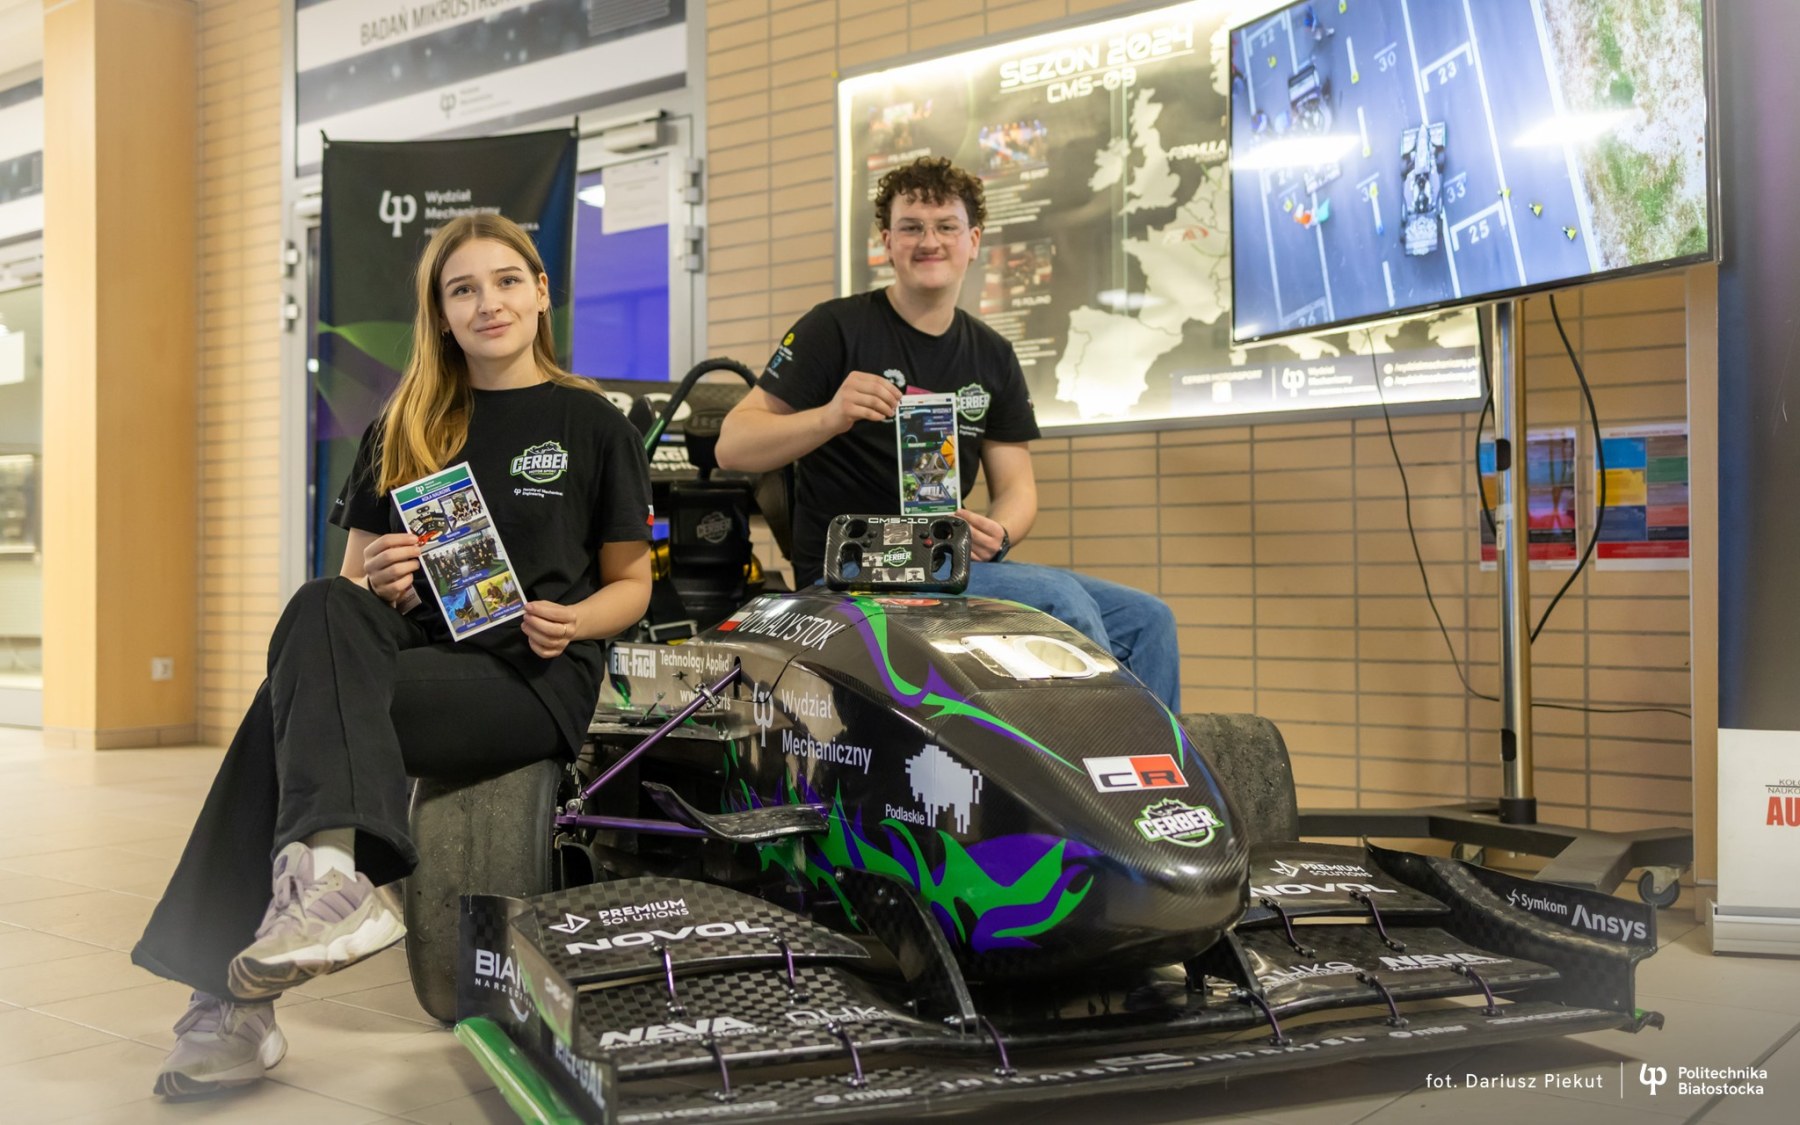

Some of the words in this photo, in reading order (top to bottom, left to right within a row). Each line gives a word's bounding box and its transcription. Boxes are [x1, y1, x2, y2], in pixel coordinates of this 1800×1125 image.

[1259, 28, 1275, 48] 22
[1000, 45, 1099, 89] SEZON
[1106, 22, 1194, 66] 2024
[1378, 52, 1397, 72] 30
[1438, 61, 1457, 85] 23
[1046, 67, 1137, 103] CMS-09
[1446, 182, 1466, 204] 33
[1469, 219, 1490, 243] 25
[868, 517, 928, 525] CMS-10
[660, 649, 705, 673] Technology
[781, 688, 832, 720] Wydział
[781, 730, 872, 774] Mechaniczny
[885, 803, 925, 825] Podlaskie
[1138, 807, 1219, 839] CERBER
[1300, 862, 1366, 873] PREMIUM
[1308, 870, 1374, 878] SOLUTIONS
[1250, 882, 1398, 898] NOVOL
[598, 898, 687, 919] PREMIUM
[1521, 893, 1568, 916] Symkom
[1571, 904, 1647, 942] Ansys
[565, 920, 771, 955] NOVOL
[1379, 952, 1493, 969] NEVA
[599, 1016, 755, 1046] NEVA
